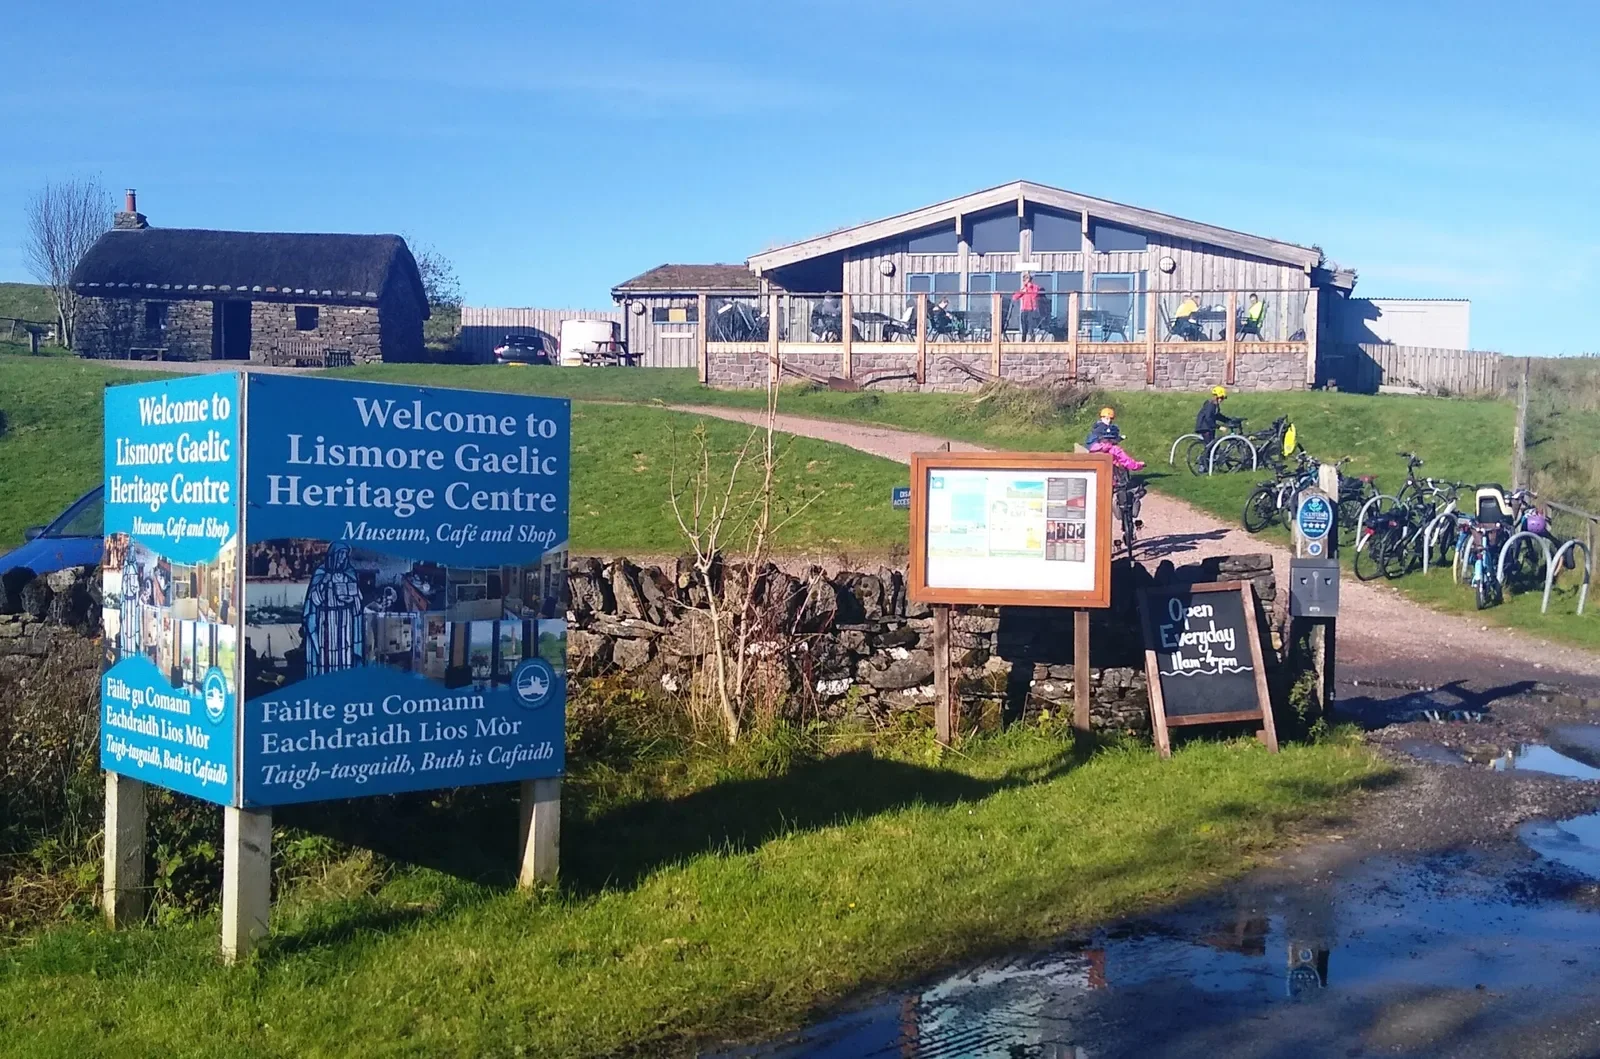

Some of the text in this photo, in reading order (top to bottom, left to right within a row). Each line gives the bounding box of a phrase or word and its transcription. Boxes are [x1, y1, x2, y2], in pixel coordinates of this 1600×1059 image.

[139, 392, 230, 426] Welcome to
[353, 397, 557, 438] Welcome to
[116, 429, 230, 466] Lismore Gaelic
[286, 434, 557, 475] Lismore Gaelic
[110, 473, 229, 512] Heritage Centre
[266, 475, 557, 518] Heritage Centre
[132, 516, 229, 545] Museum, Café and Shop
[341, 521, 557, 548] Museum, Café and Shop
[1168, 598, 1213, 630] Open
[1160, 620, 1236, 653] Everyday
[107, 677, 130, 701] Fàilte
[132, 688, 144, 709] gu
[146, 686, 190, 715] Comann
[261, 694, 485, 724] Fàilte gu Comann
[106, 705, 210, 750] Eachdraidh Lios Mòr
[260, 716, 522, 754] Eachdraidh Lios Mòr
[163, 749, 183, 774] Buth
[184, 756, 192, 775] is
[192, 757, 228, 786] Cafaidh
[261, 741, 554, 789] Taigh-tasgaidh, Buth is Cafaidh
